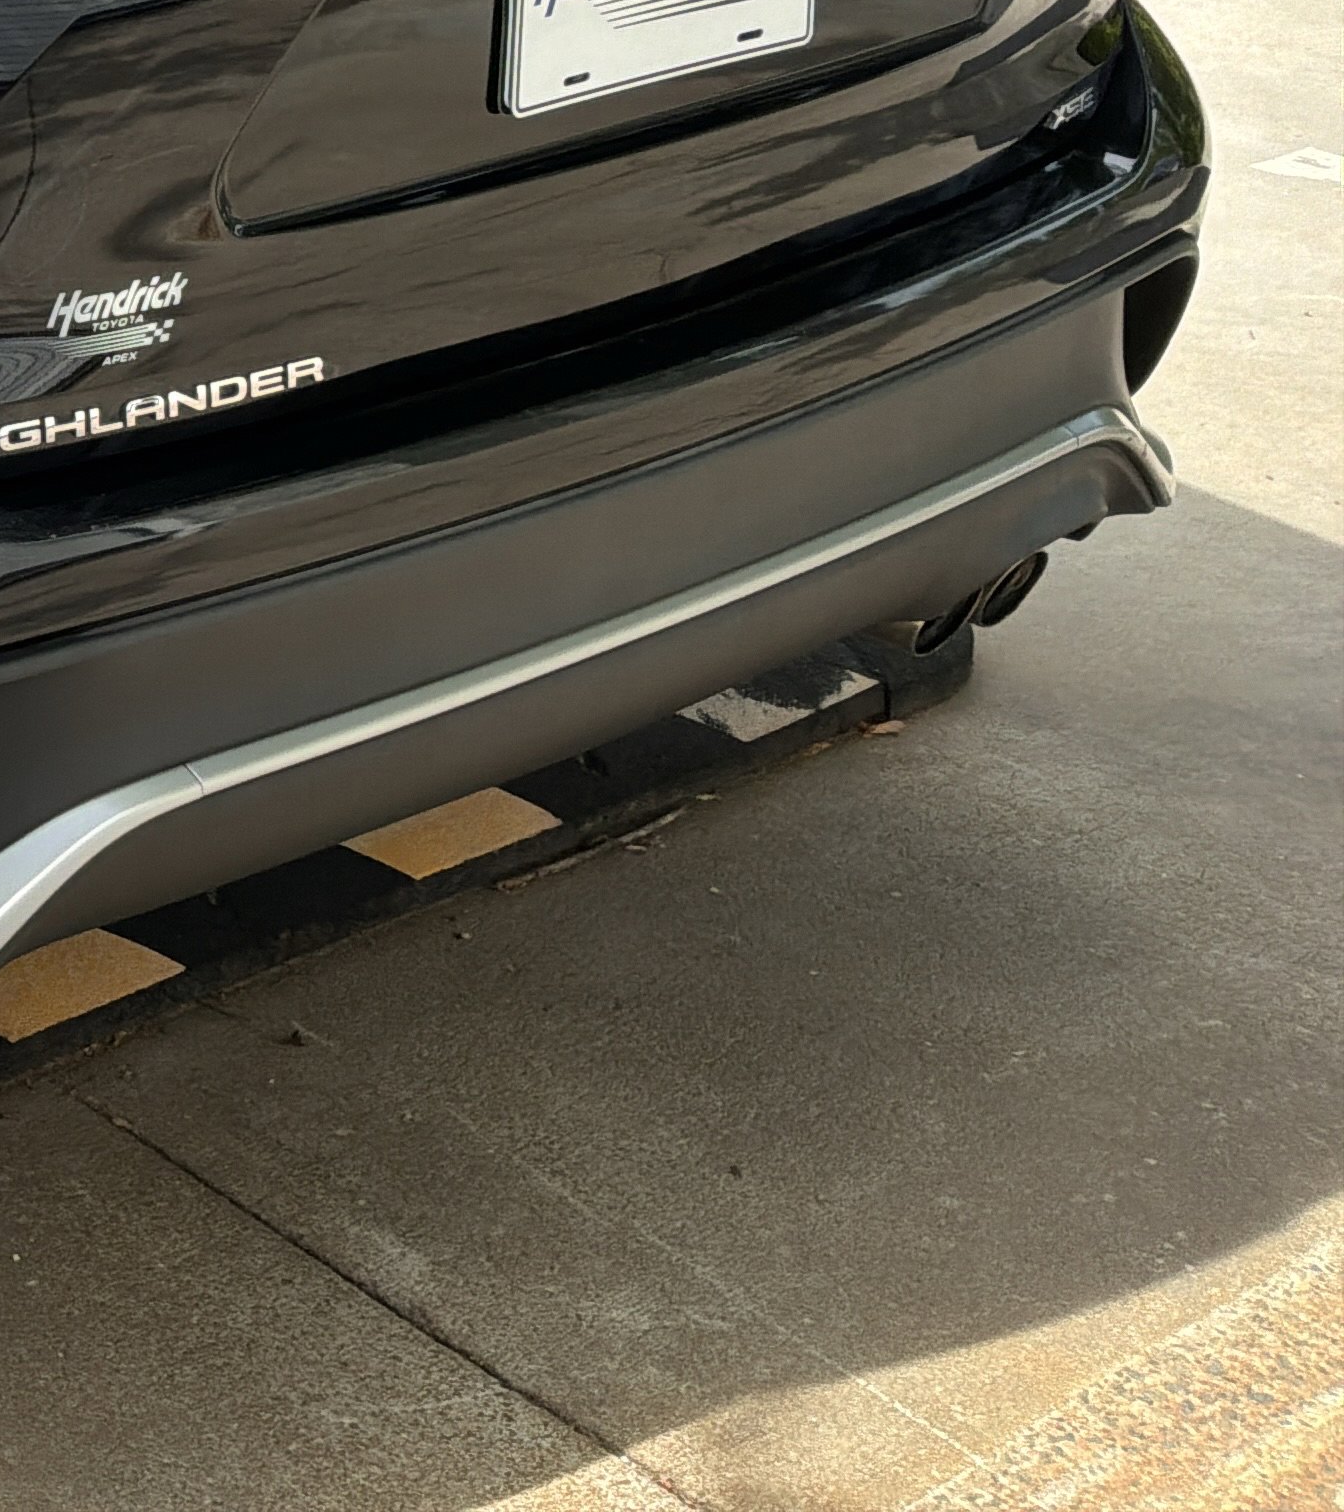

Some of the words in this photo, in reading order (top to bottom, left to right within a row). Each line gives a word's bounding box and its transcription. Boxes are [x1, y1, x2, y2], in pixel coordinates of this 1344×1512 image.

[46, 271, 189, 338] Hendrick
[91, 313, 145, 333] TOYOTA
[101, 350, 139, 368] APEX
